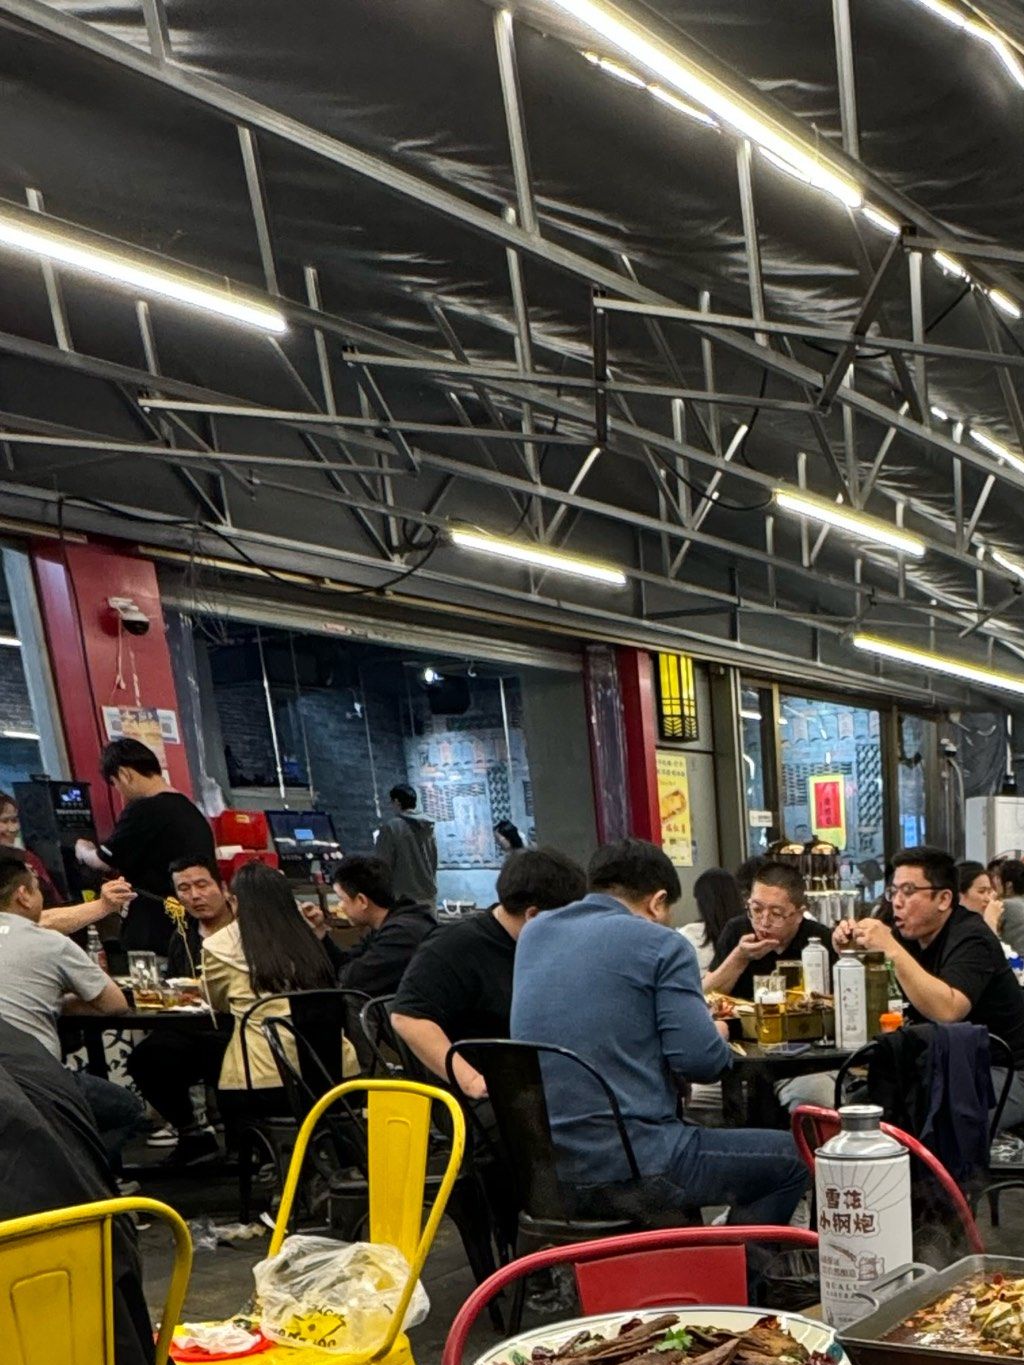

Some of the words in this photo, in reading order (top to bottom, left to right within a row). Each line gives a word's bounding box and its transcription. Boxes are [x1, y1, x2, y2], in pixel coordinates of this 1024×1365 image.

[825, 1188, 862, 1209] 雪花
[820, 1210, 876, 1234] 小钢炮
